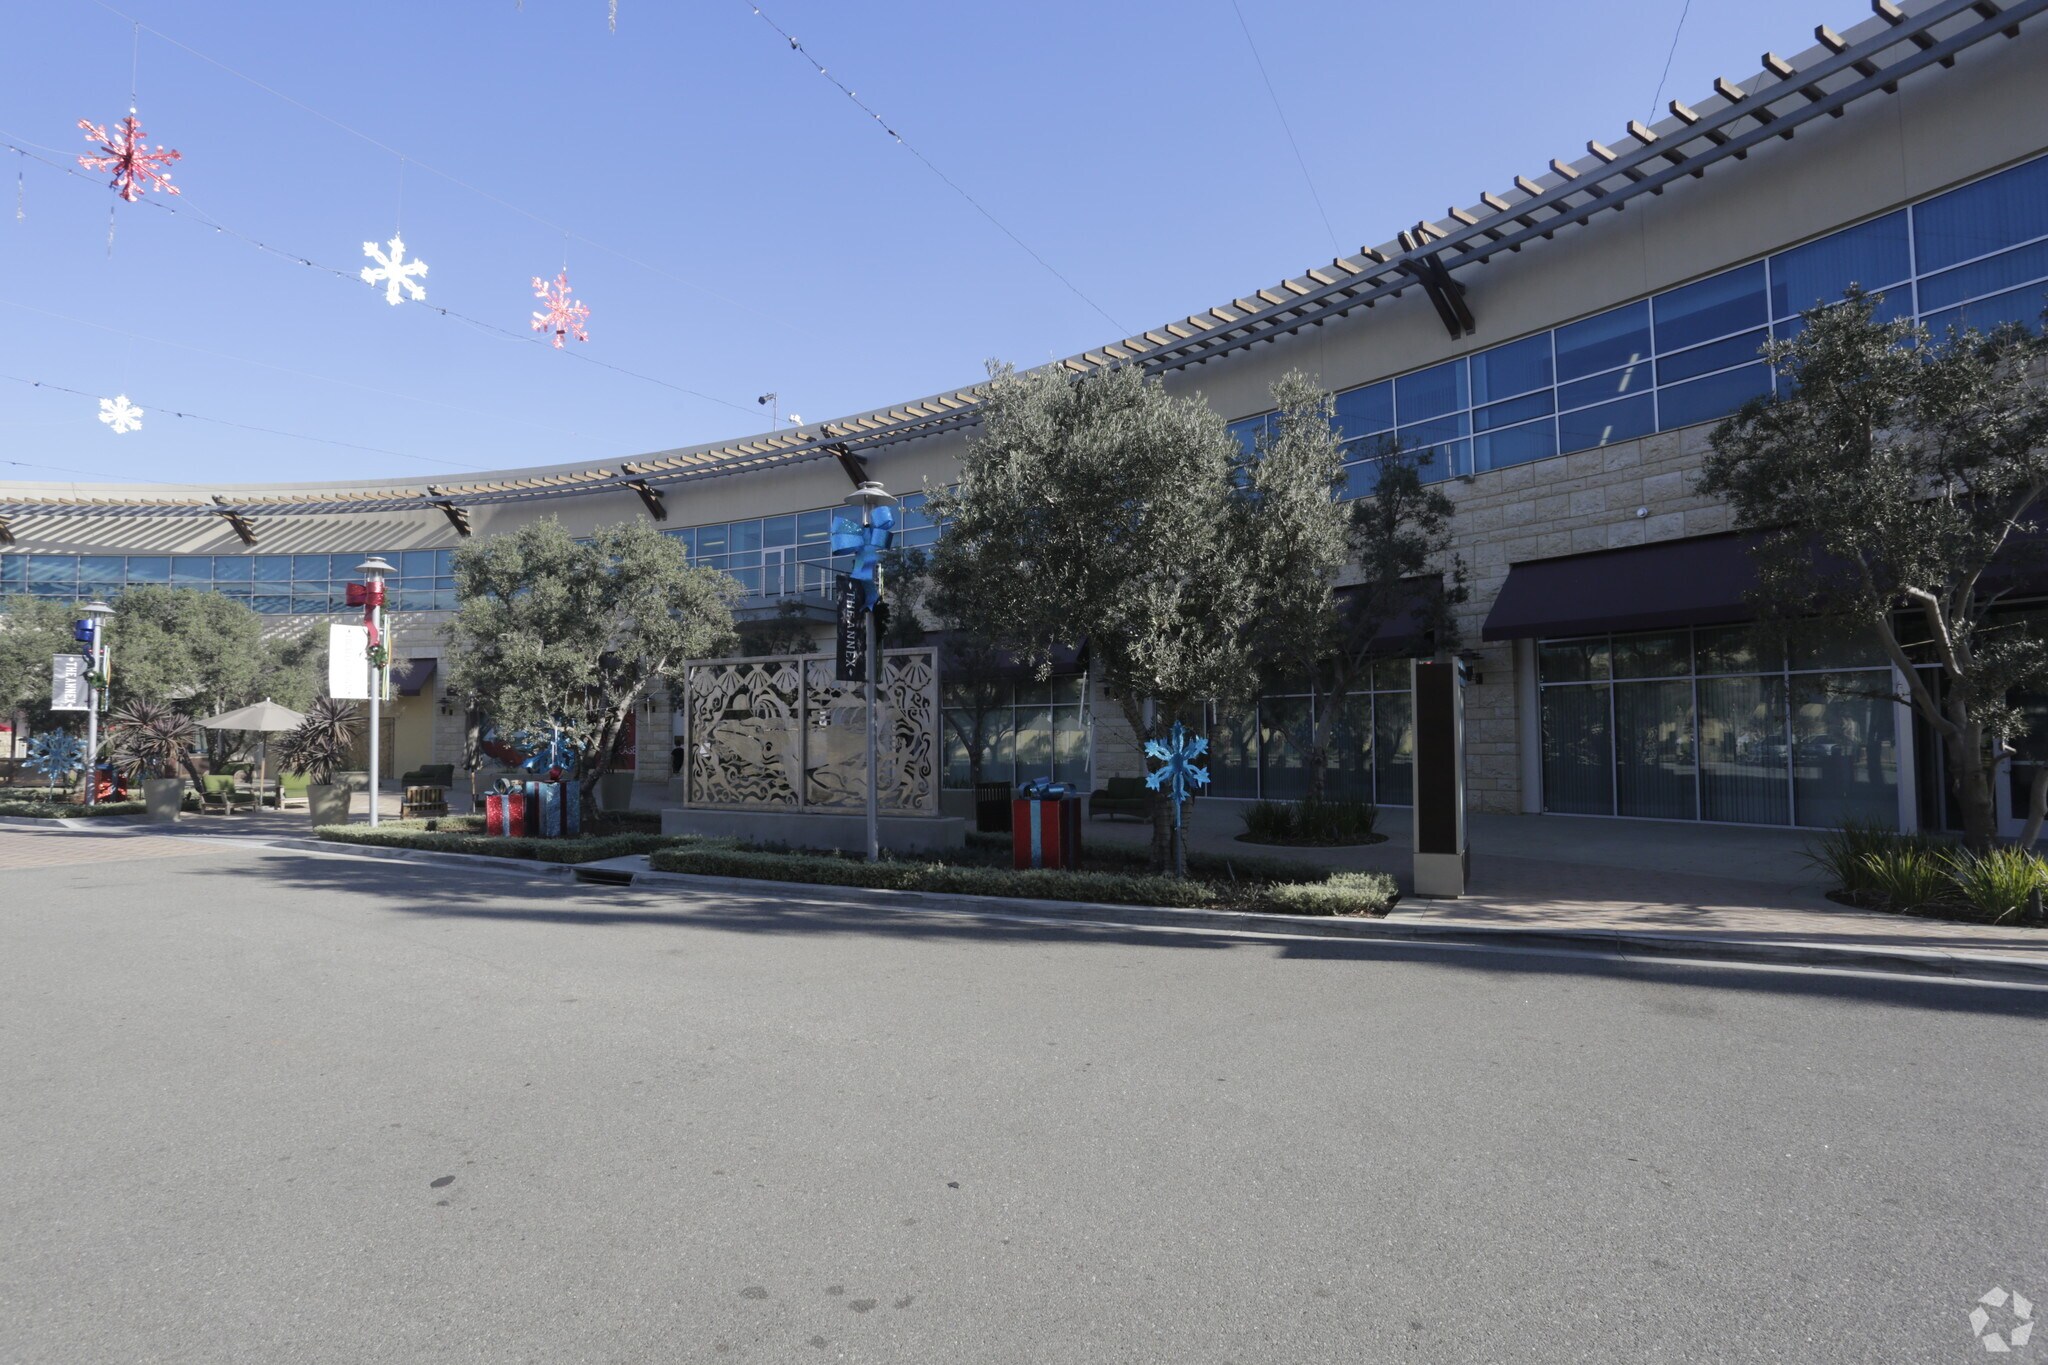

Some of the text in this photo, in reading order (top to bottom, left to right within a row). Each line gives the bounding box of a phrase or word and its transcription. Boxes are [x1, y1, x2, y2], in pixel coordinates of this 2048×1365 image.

[845, 592, 856, 667] THE ANNEX
[64, 661, 78, 704] THE ANNEX
